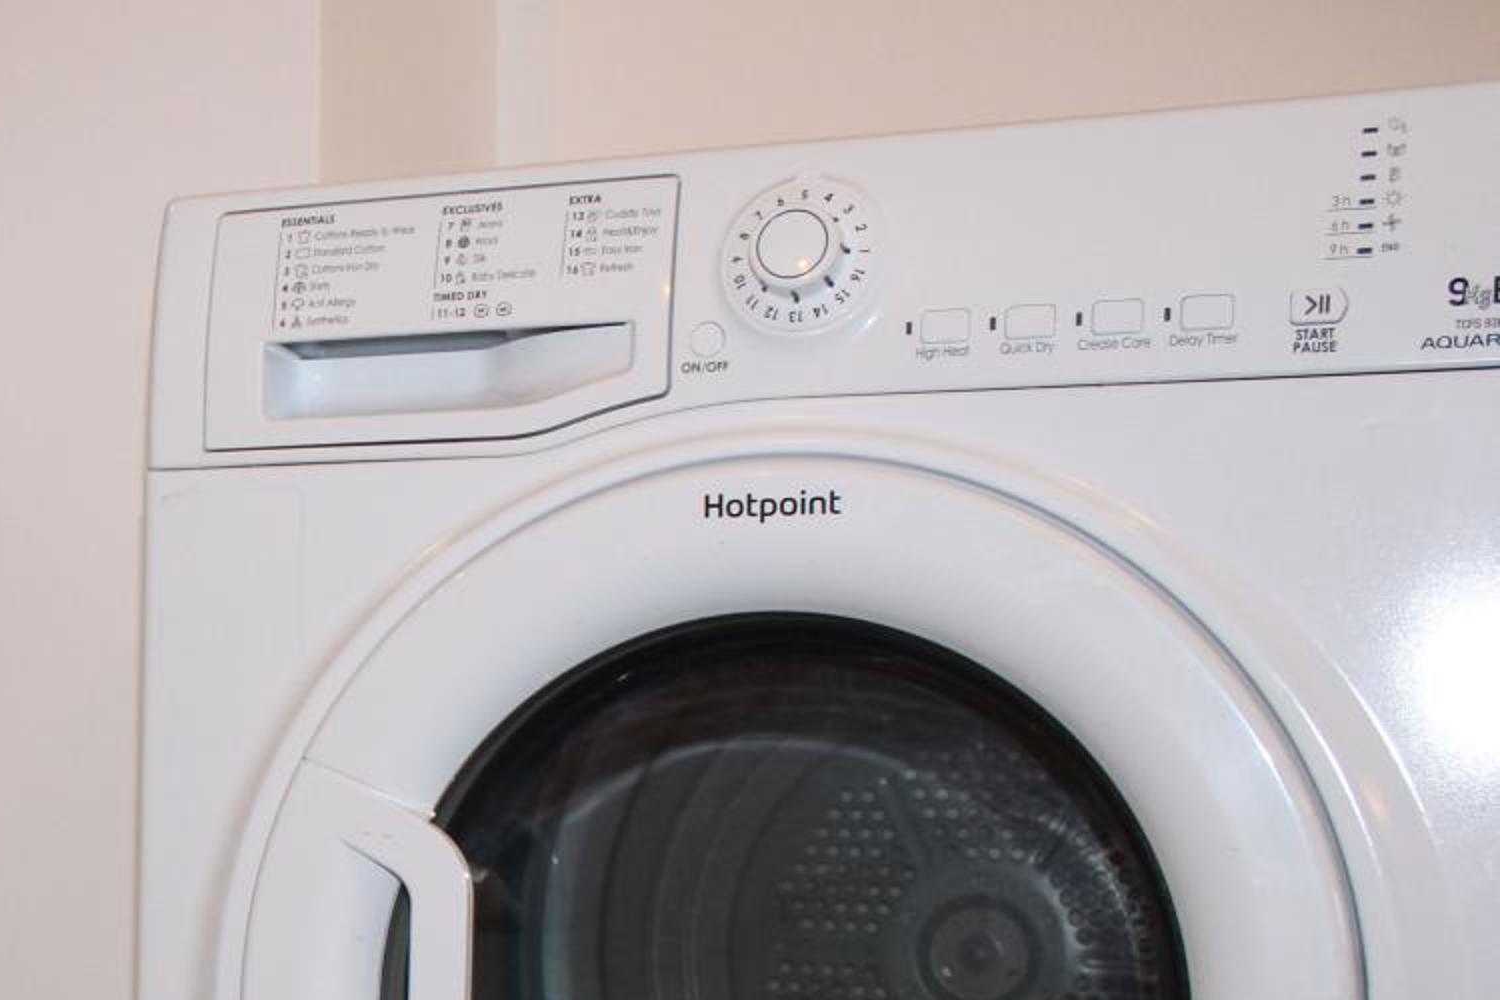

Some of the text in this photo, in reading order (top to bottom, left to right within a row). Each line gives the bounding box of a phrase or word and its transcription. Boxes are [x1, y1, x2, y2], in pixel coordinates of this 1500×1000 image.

[569, 194, 602, 205] EXTRA
[442, 201, 503, 216] EXCLUSIVES
[281, 215, 335, 228] ESSENTIALS
[1169, 332, 1239, 349] Delay Timer
[1295, 327, 1335, 341] START
[1000, 340, 1055, 356] Quick Dry
[1293, 340, 1337, 353] PAUSE
[681, 360, 729, 374] ON/OFF
[703, 489, 842, 524] Hotpoint
